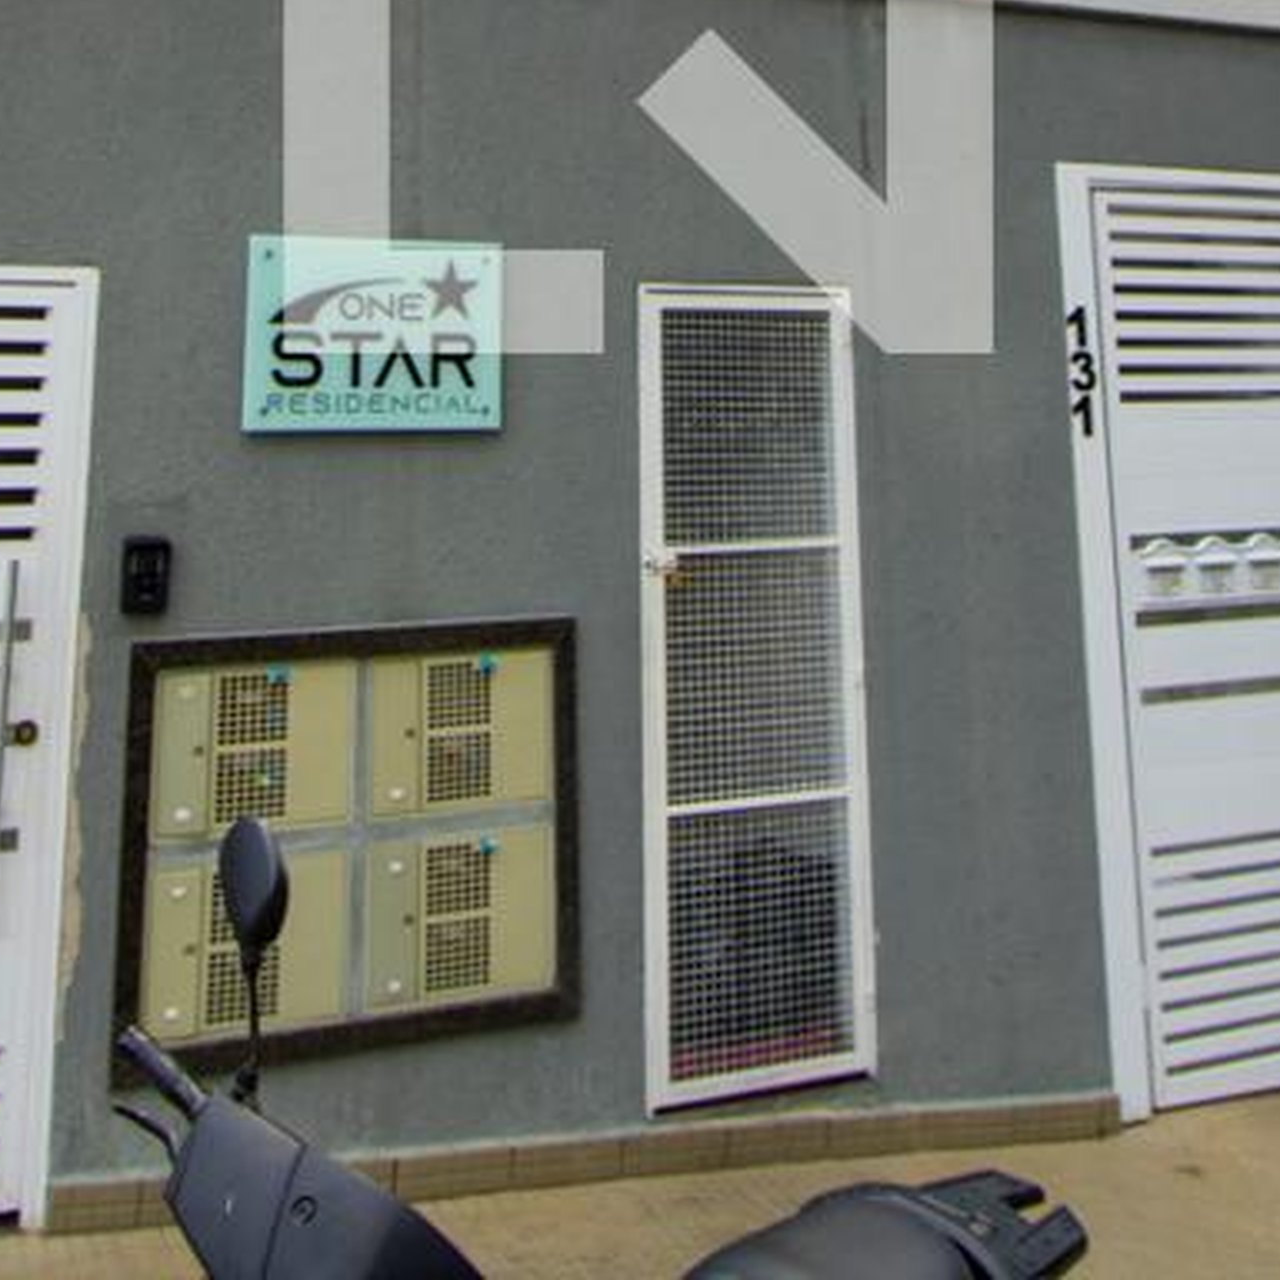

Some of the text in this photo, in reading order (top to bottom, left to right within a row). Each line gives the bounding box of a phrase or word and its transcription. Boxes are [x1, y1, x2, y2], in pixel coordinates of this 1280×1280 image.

[339, 293, 424, 321] ONE
[272, 332, 477, 388] STAR
[1066, 306, 1097, 436] 131
[266, 393, 481, 415] RESIDENCIAL
